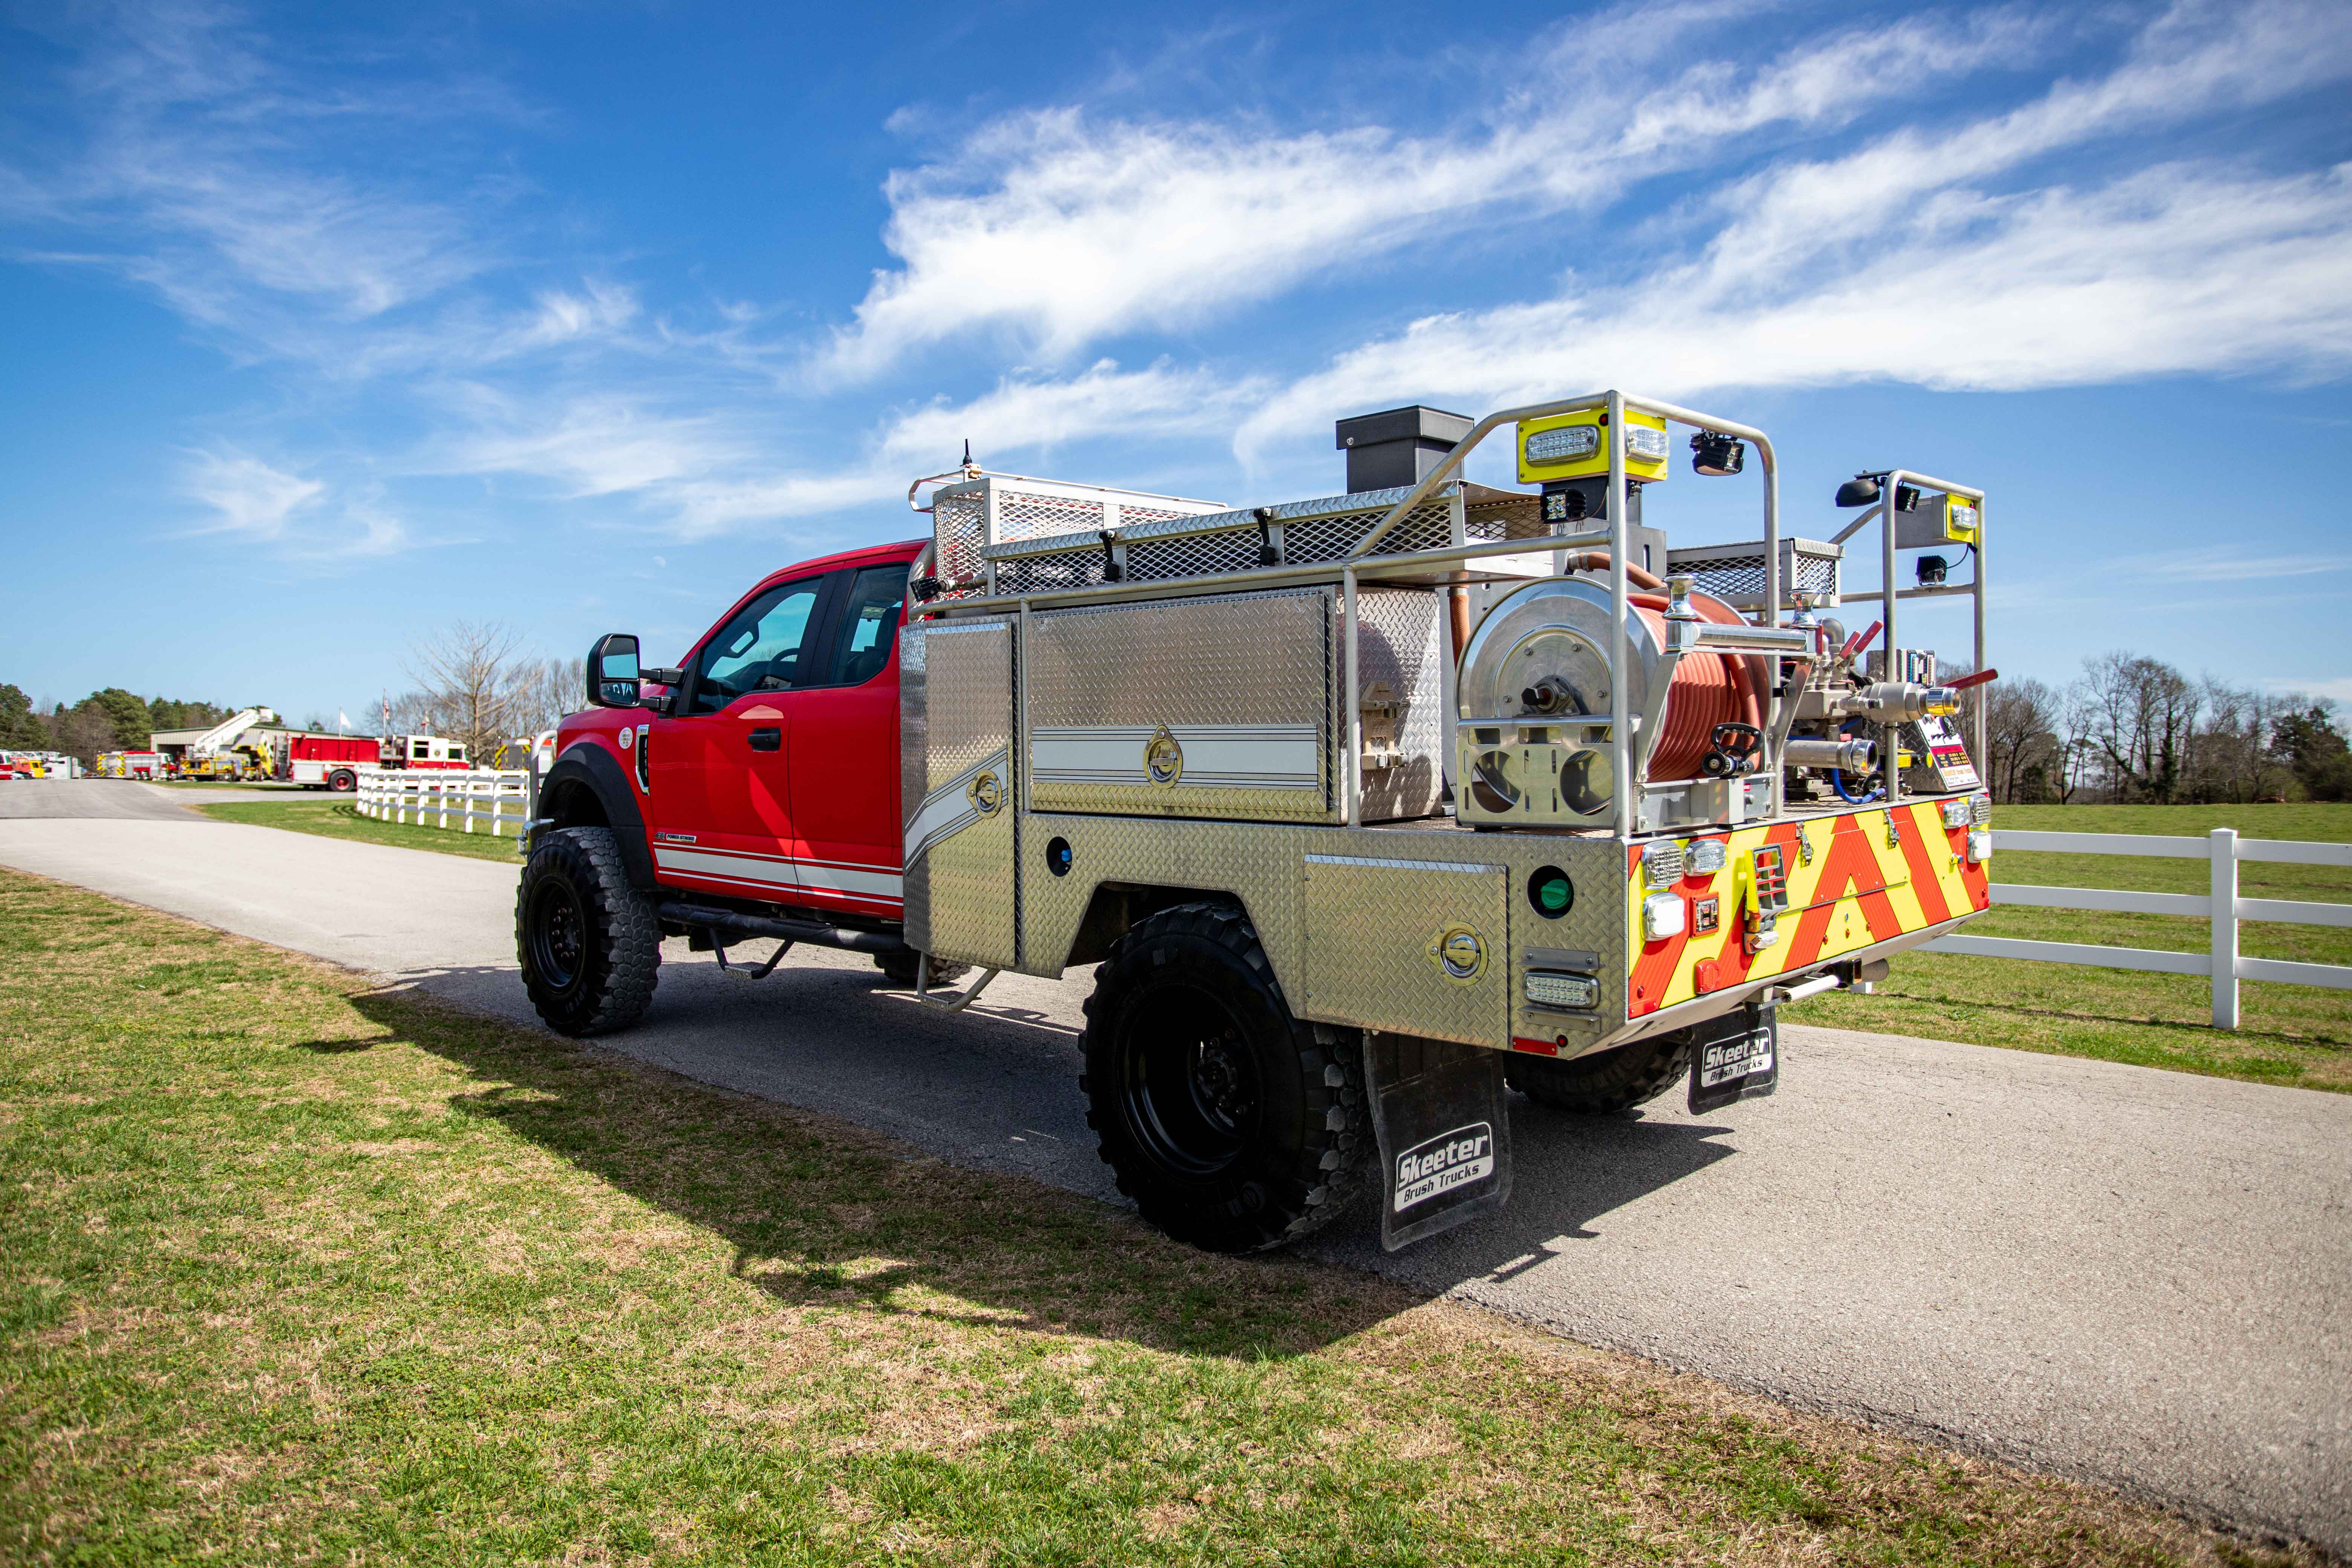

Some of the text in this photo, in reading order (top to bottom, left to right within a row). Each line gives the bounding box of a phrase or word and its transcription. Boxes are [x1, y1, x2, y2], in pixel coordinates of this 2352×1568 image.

[1705, 1037, 1769, 1070] Skeeter
[1710, 1059, 1762, 1081] Brsh Trucks
[1399, 1135, 1488, 1189] Skeeter
[1404, 1164, 1479, 1203] Brush Trucks
